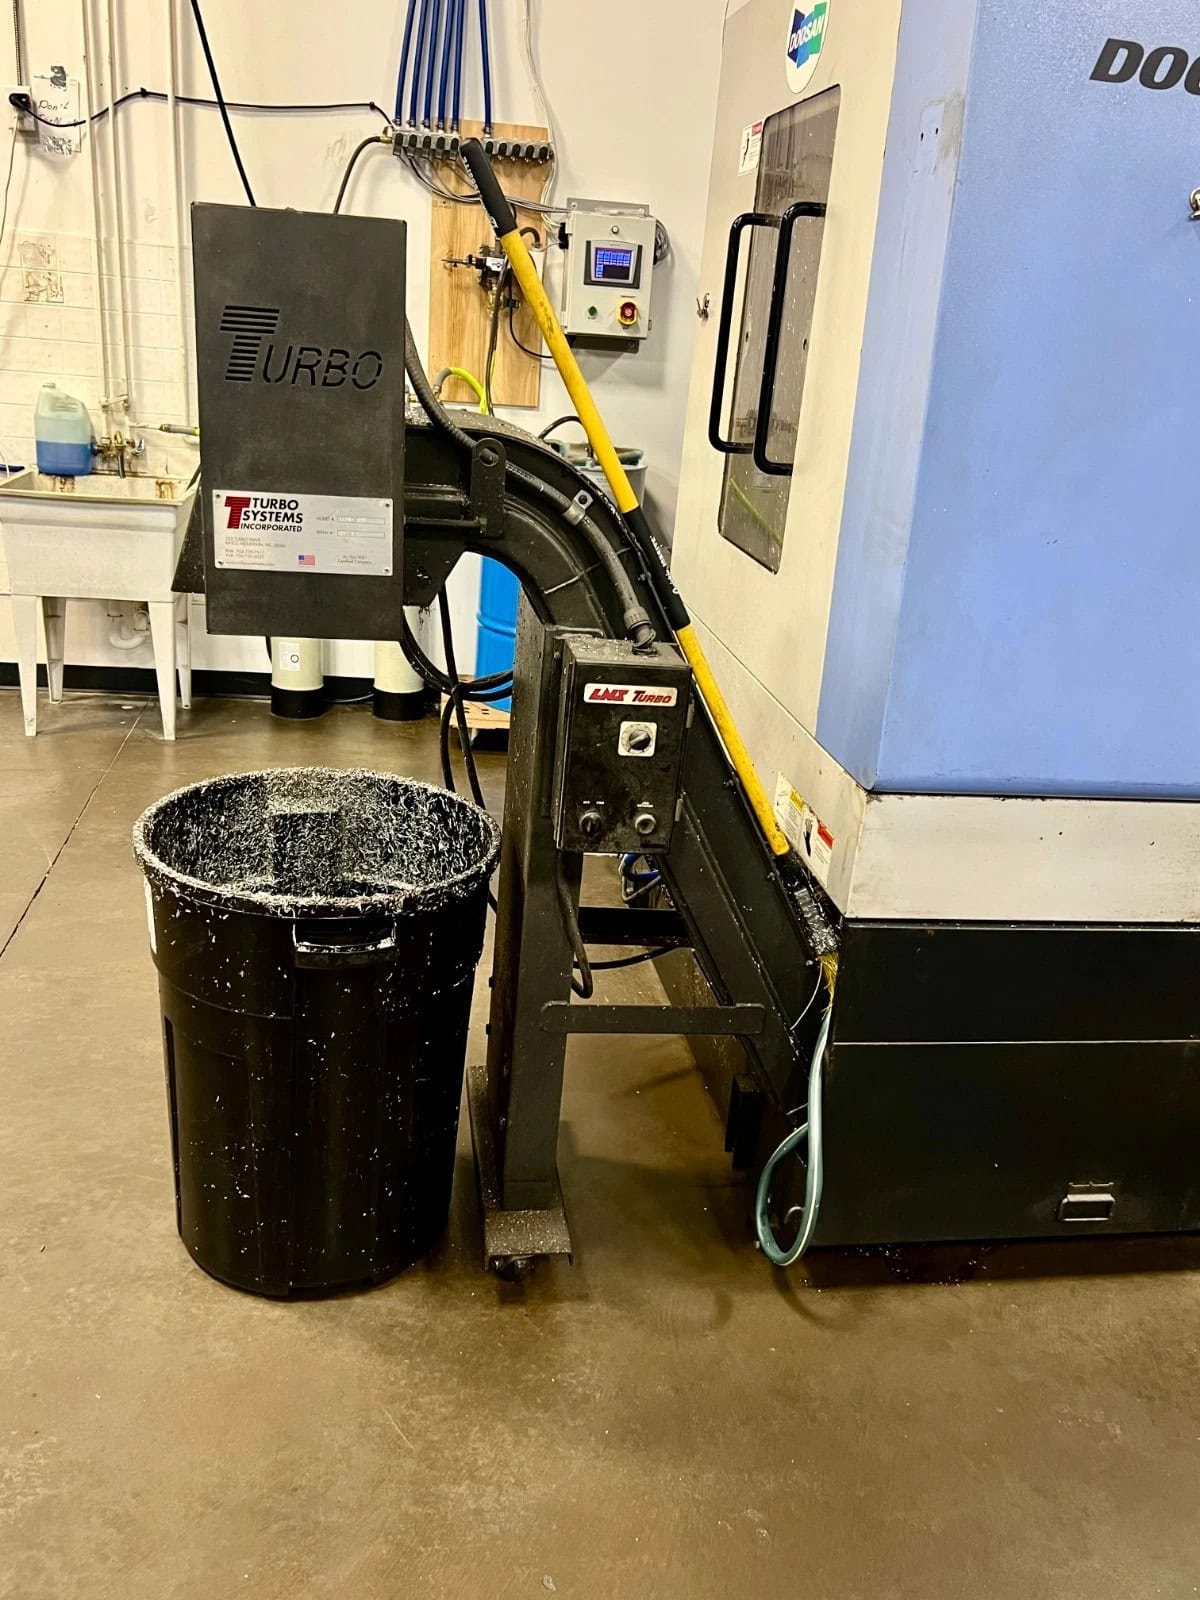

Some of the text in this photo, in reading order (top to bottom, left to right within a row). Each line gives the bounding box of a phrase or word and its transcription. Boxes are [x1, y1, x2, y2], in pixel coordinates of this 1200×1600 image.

[789, 14, 825, 53] DOOSAN
[219, 305, 383, 390] TURBO
[252, 497, 299, 511] TURBO
[242, 510, 303, 524] SYSTEMS
[240, 523, 303, 533] INCORPORATED
[631, 690, 673, 704] TURBO
